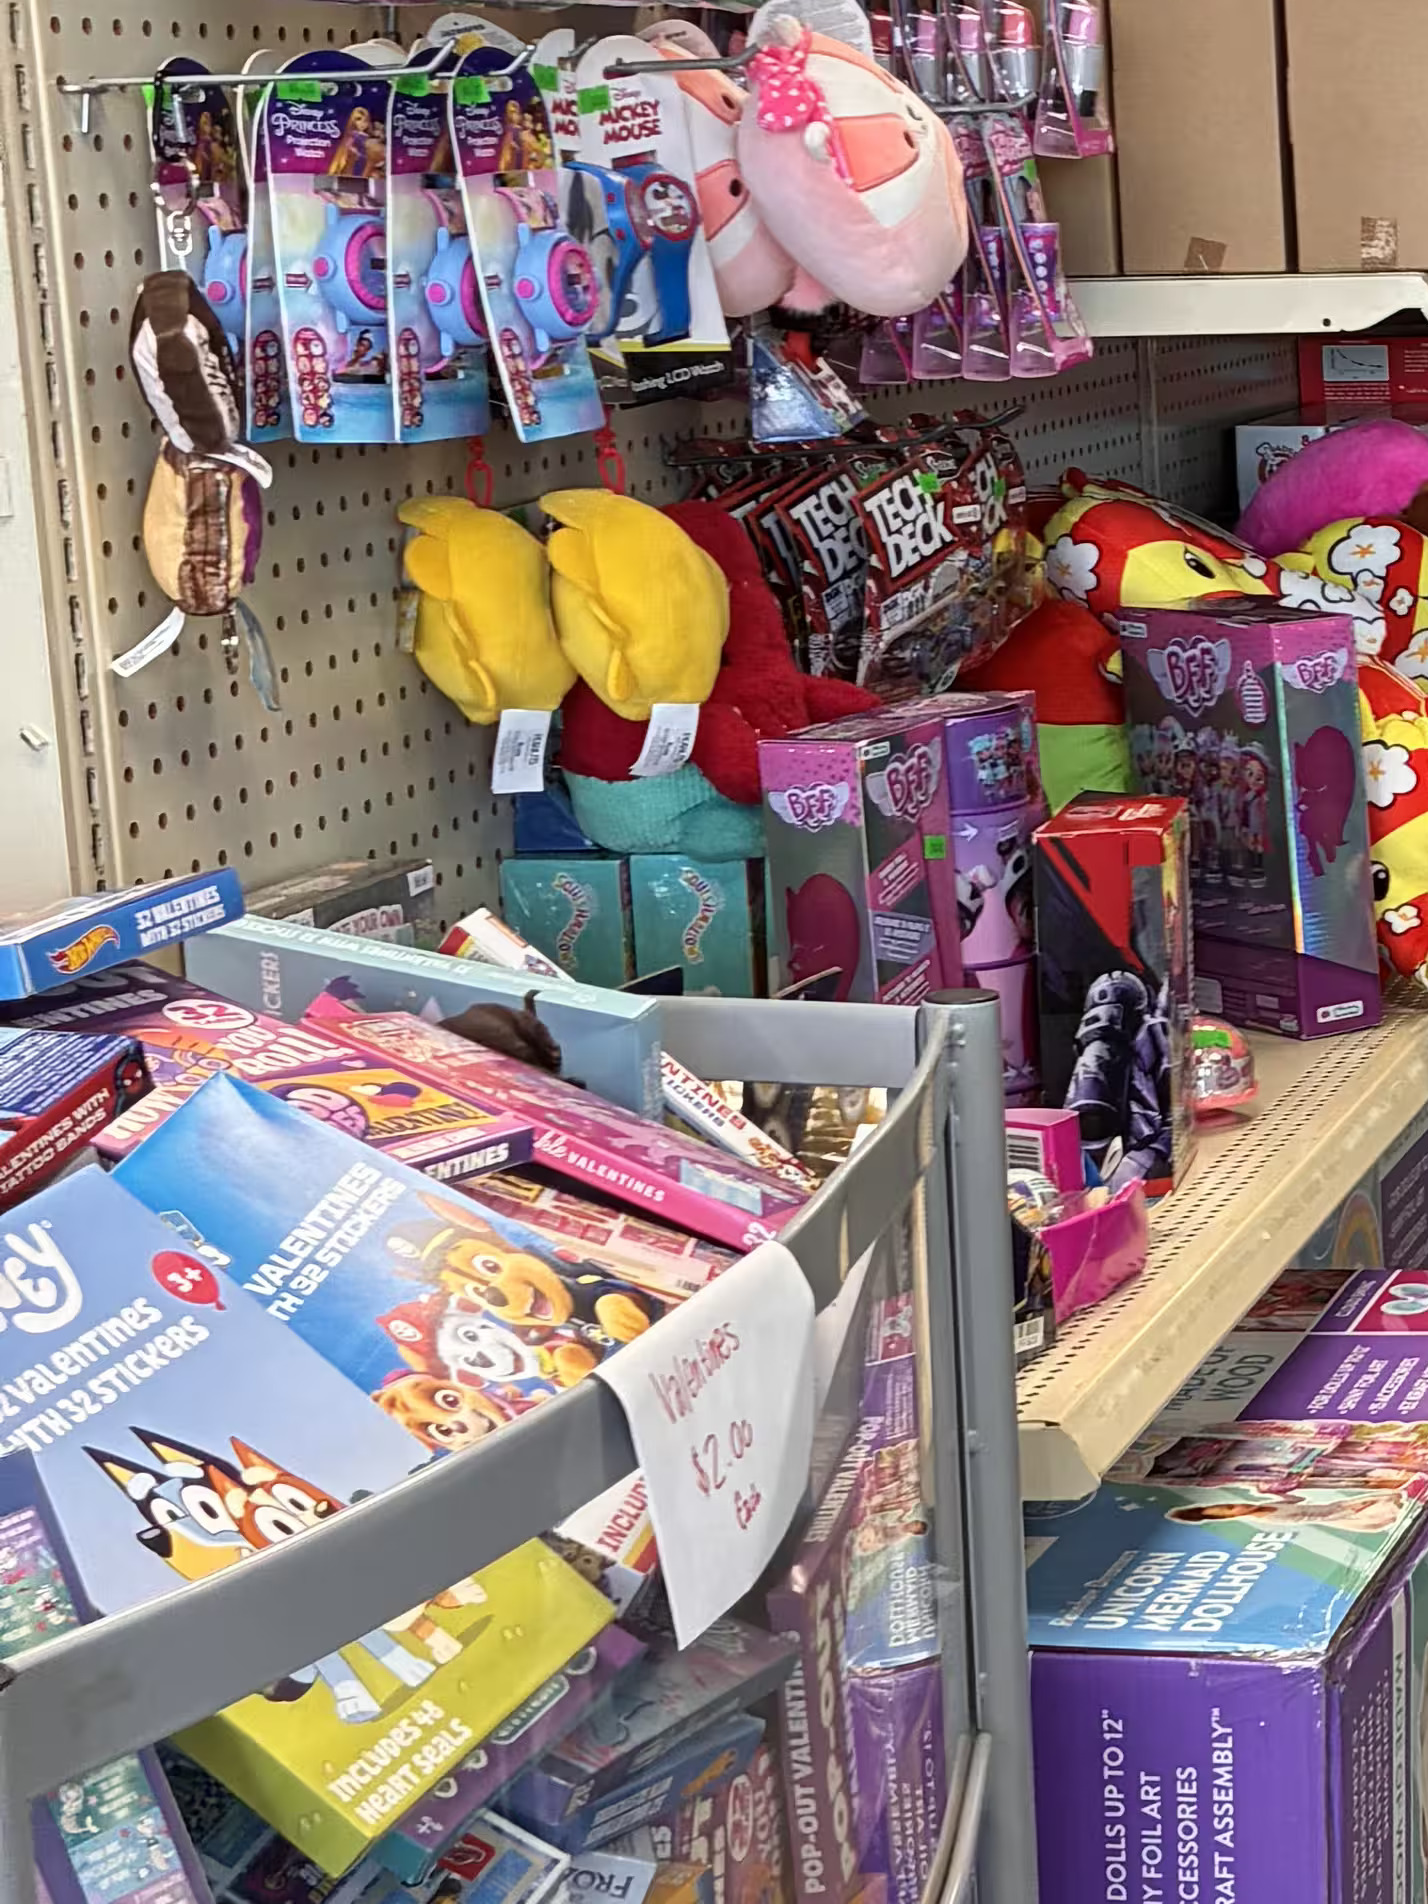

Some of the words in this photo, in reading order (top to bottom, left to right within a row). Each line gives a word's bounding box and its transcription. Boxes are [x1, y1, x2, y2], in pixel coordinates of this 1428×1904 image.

[272, 115, 340, 140] PRINCESS
[598, 101, 660, 127] MICKEY
[603, 119, 661, 146] MOUSE
[789, 474, 856, 539] TECH
[864, 468, 931, 533] TECH
[889, 501, 954, 578] DECK
[1164, 641, 1215, 706] BFF
[135, 910, 152, 930] 32
[150, 885, 221, 925] VALENTINES
[182, 904, 227, 934] STICKERS
[215, 1026, 276, 1055] YOU
[72, 1088, 110, 1120] WITH
[56, 1107, 107, 1155] BANDS
[567, 1149, 665, 1202] VALENTINES
[243, 1163, 382, 1296] VALENTINES
[322, 1177, 407, 1269] STICKERS
[166, 1264, 204, 1294] 3+
[648, 1322, 740, 1424] Valentines
[1203, 1353, 1277, 1405] WOOD
[65, 1394, 100, 1424] 32
[690, 1419, 753, 1497] $2.00
[1084, 1551, 1186, 1632] UNICORN
[1133, 1549, 1231, 1633] MERMAID
[1180, 1531, 1295, 1634] DOLLHOUSE
[1101, 1709, 1124, 1740] 12"
[1102, 1746, 1125, 1780] TO
[1104, 1784, 1126, 1818] UP
[1140, 1771, 1162, 1819] ART
[794, 1781, 825, 1894] POP-OUT
[1105, 1823, 1128, 1901] DOLLS
[1140, 1823, 1163, 1879] FOIL
